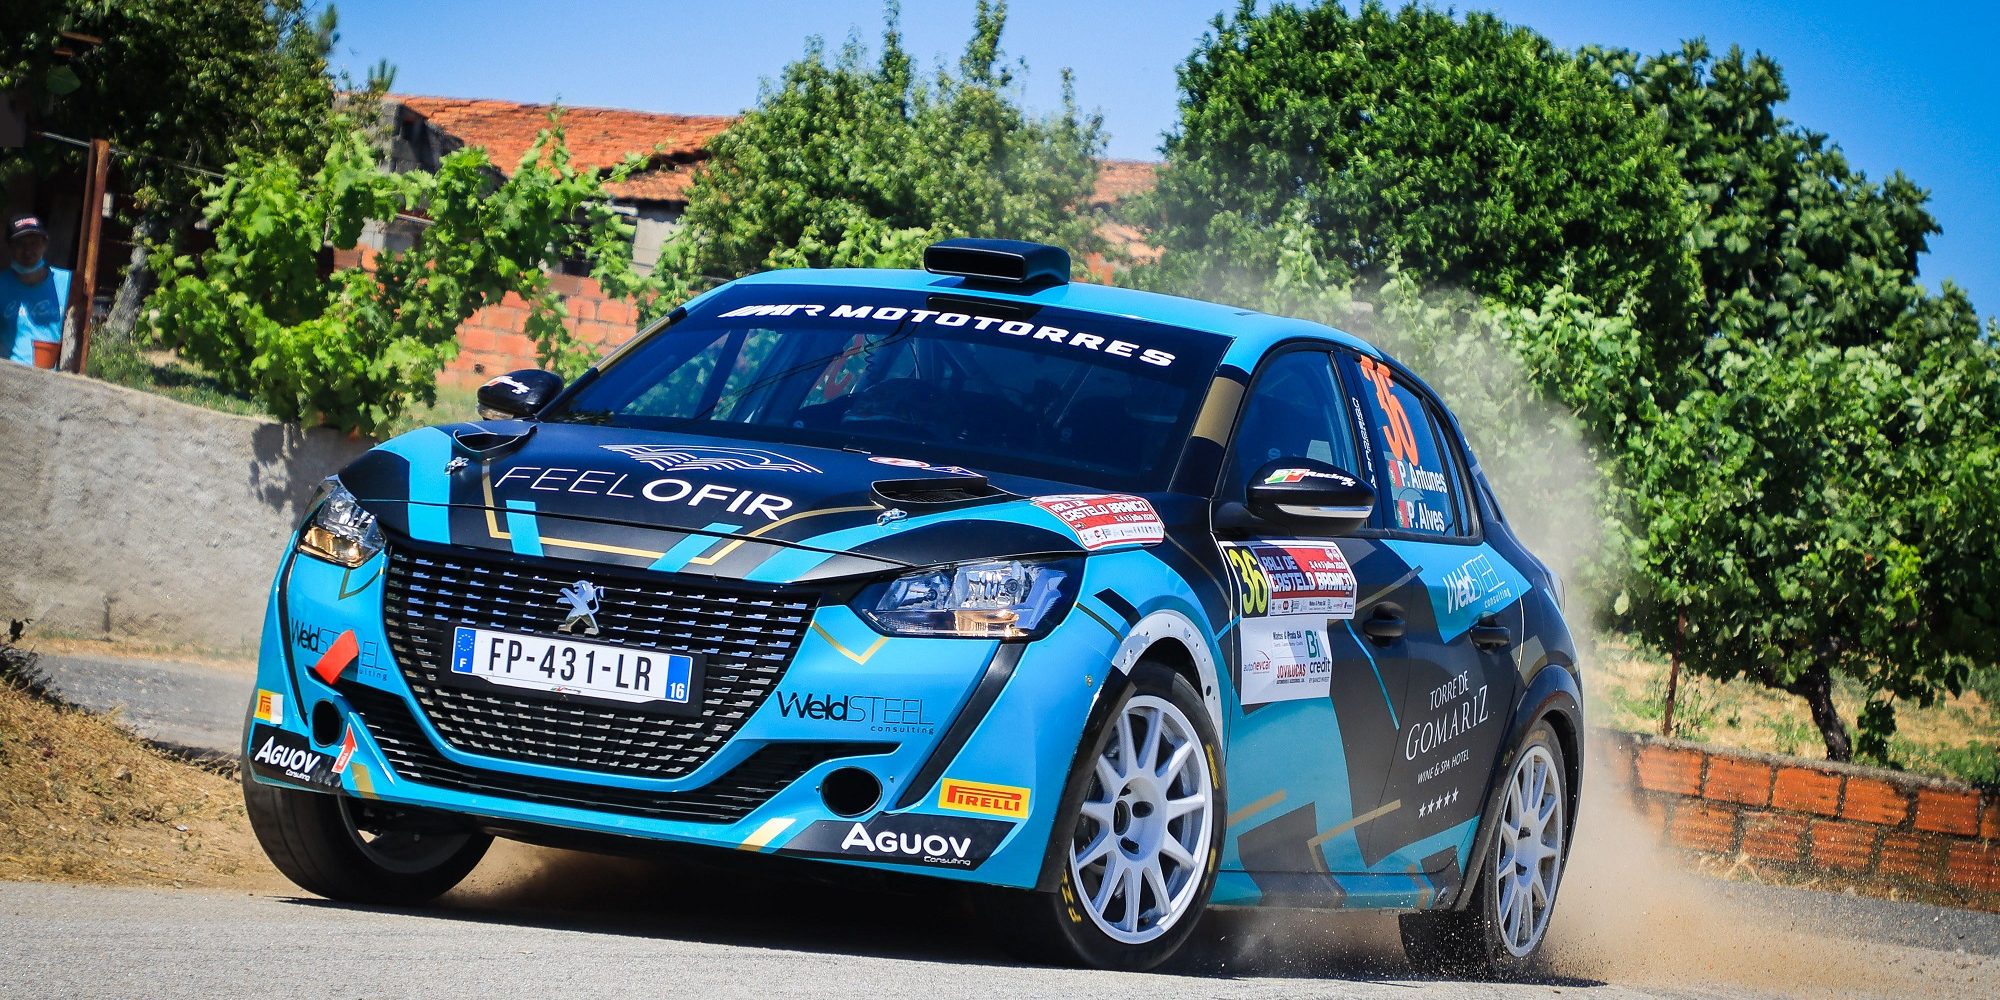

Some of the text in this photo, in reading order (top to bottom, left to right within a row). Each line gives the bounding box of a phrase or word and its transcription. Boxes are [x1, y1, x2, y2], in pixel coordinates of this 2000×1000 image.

[829, 305, 1175, 366] MOTOTORRES
[1360, 355, 1419, 467] 36
[1397, 460, 1448, 494] P. Antunes
[1049, 502, 1075, 513] RALI
[1060, 500, 1150, 522] CASTELO BRANCO
[1406, 501, 1445, 532] P. Alves
[1261, 556, 1298, 571] RALI DE
[1228, 549, 1268, 615] 36
[1268, 572, 1353, 592] CASTELO BRANCO
[1442, 553, 1506, 614] WeldSTEEL
[1484, 587, 1512, 608] consulting
[291, 617, 388, 671] WeldSTEL
[1305, 630, 1320, 658] Bi
[459, 658, 467, 668] F
[489, 637, 652, 692] FP-431-LR
[1276, 663, 1307, 679] JOVILUCAS
[1309, 657, 1331, 674] credit
[670, 682, 685, 699] 16
[1430, 670, 1470, 711] TORRE DE
[776, 691, 934, 725] WeldSTEEL
[870, 725, 934, 735] consulting
[1405, 685, 1489, 761] GOMARIZ
[255, 736, 321, 774] AGUOV
[1417, 749, 1469, 784] WINE & SPA HOTEL
[285, 769, 311, 782] Consulting
[946, 785, 1022, 812] PIRELLI
[841, 822, 971, 858] AGUOV
[923, 855, 971, 866] Consulting
